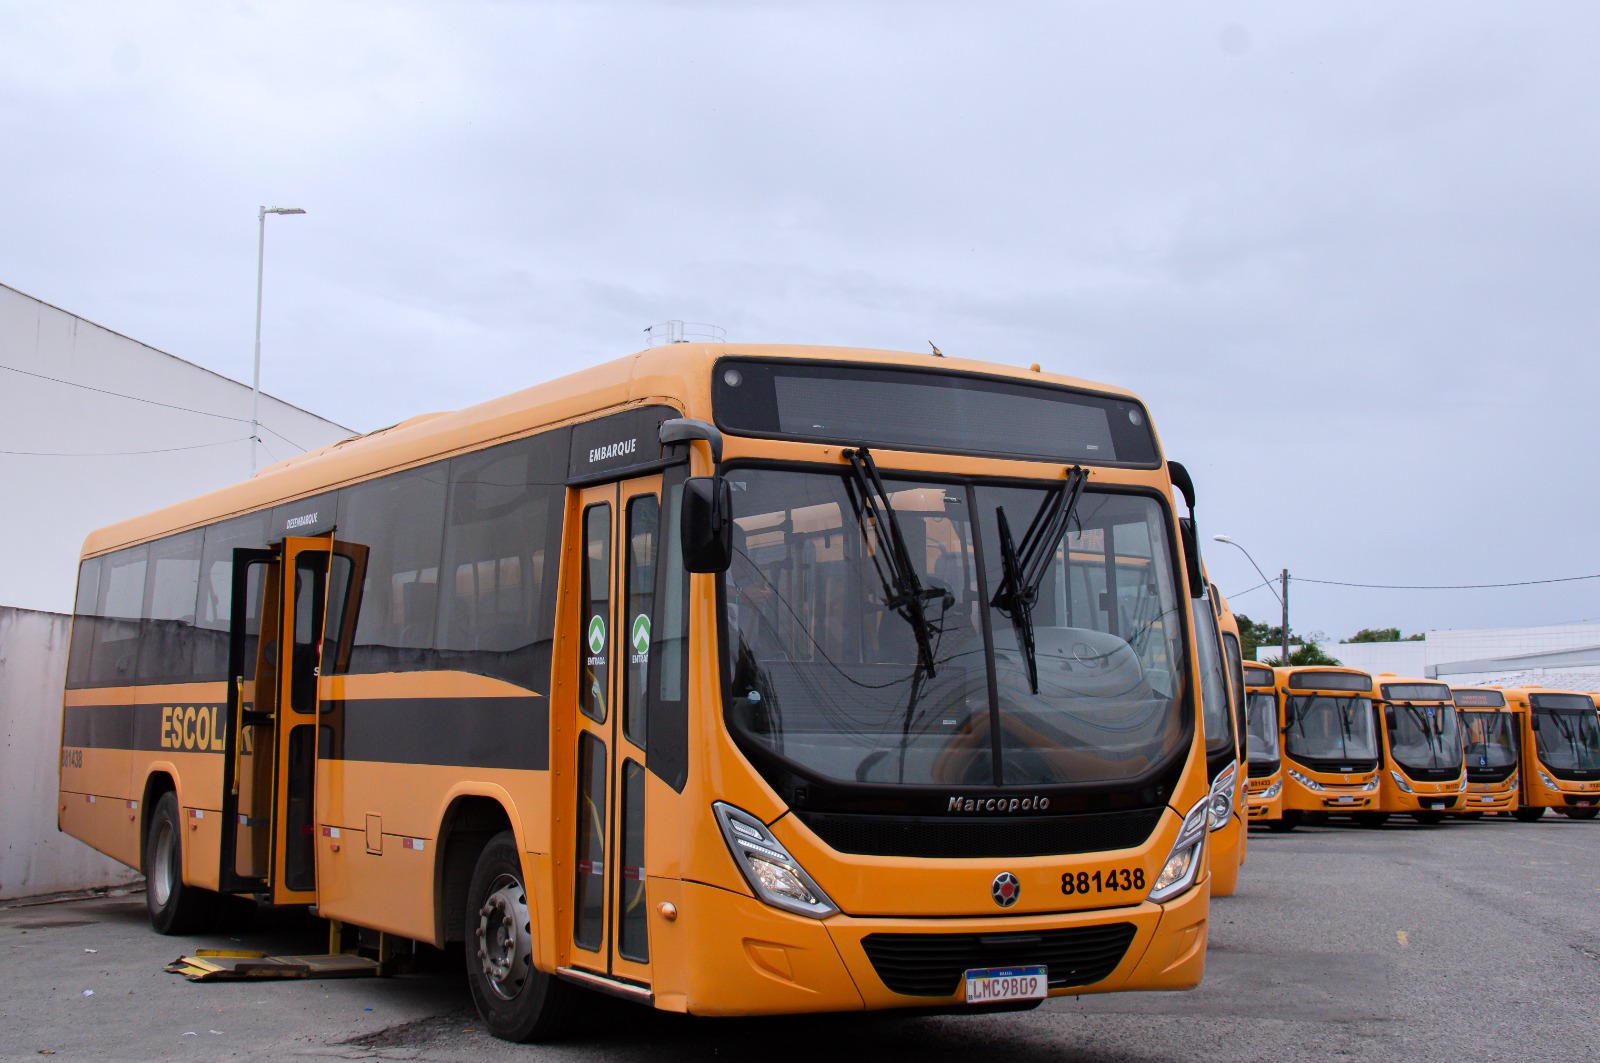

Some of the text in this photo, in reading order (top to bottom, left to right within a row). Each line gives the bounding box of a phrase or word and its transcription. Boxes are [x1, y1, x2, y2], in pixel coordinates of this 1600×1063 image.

[589, 438, 637, 463] EMBARQUE
[286, 512, 318, 529] DESEMBARQUE
[587, 656, 606, 666] ENTRADA
[161, 706, 253, 751] ESCOLR
[948, 796, 1050, 812] Marcopolo
[1061, 868, 1146, 895] 881438
[973, 977, 1038, 999] LMC9B09
